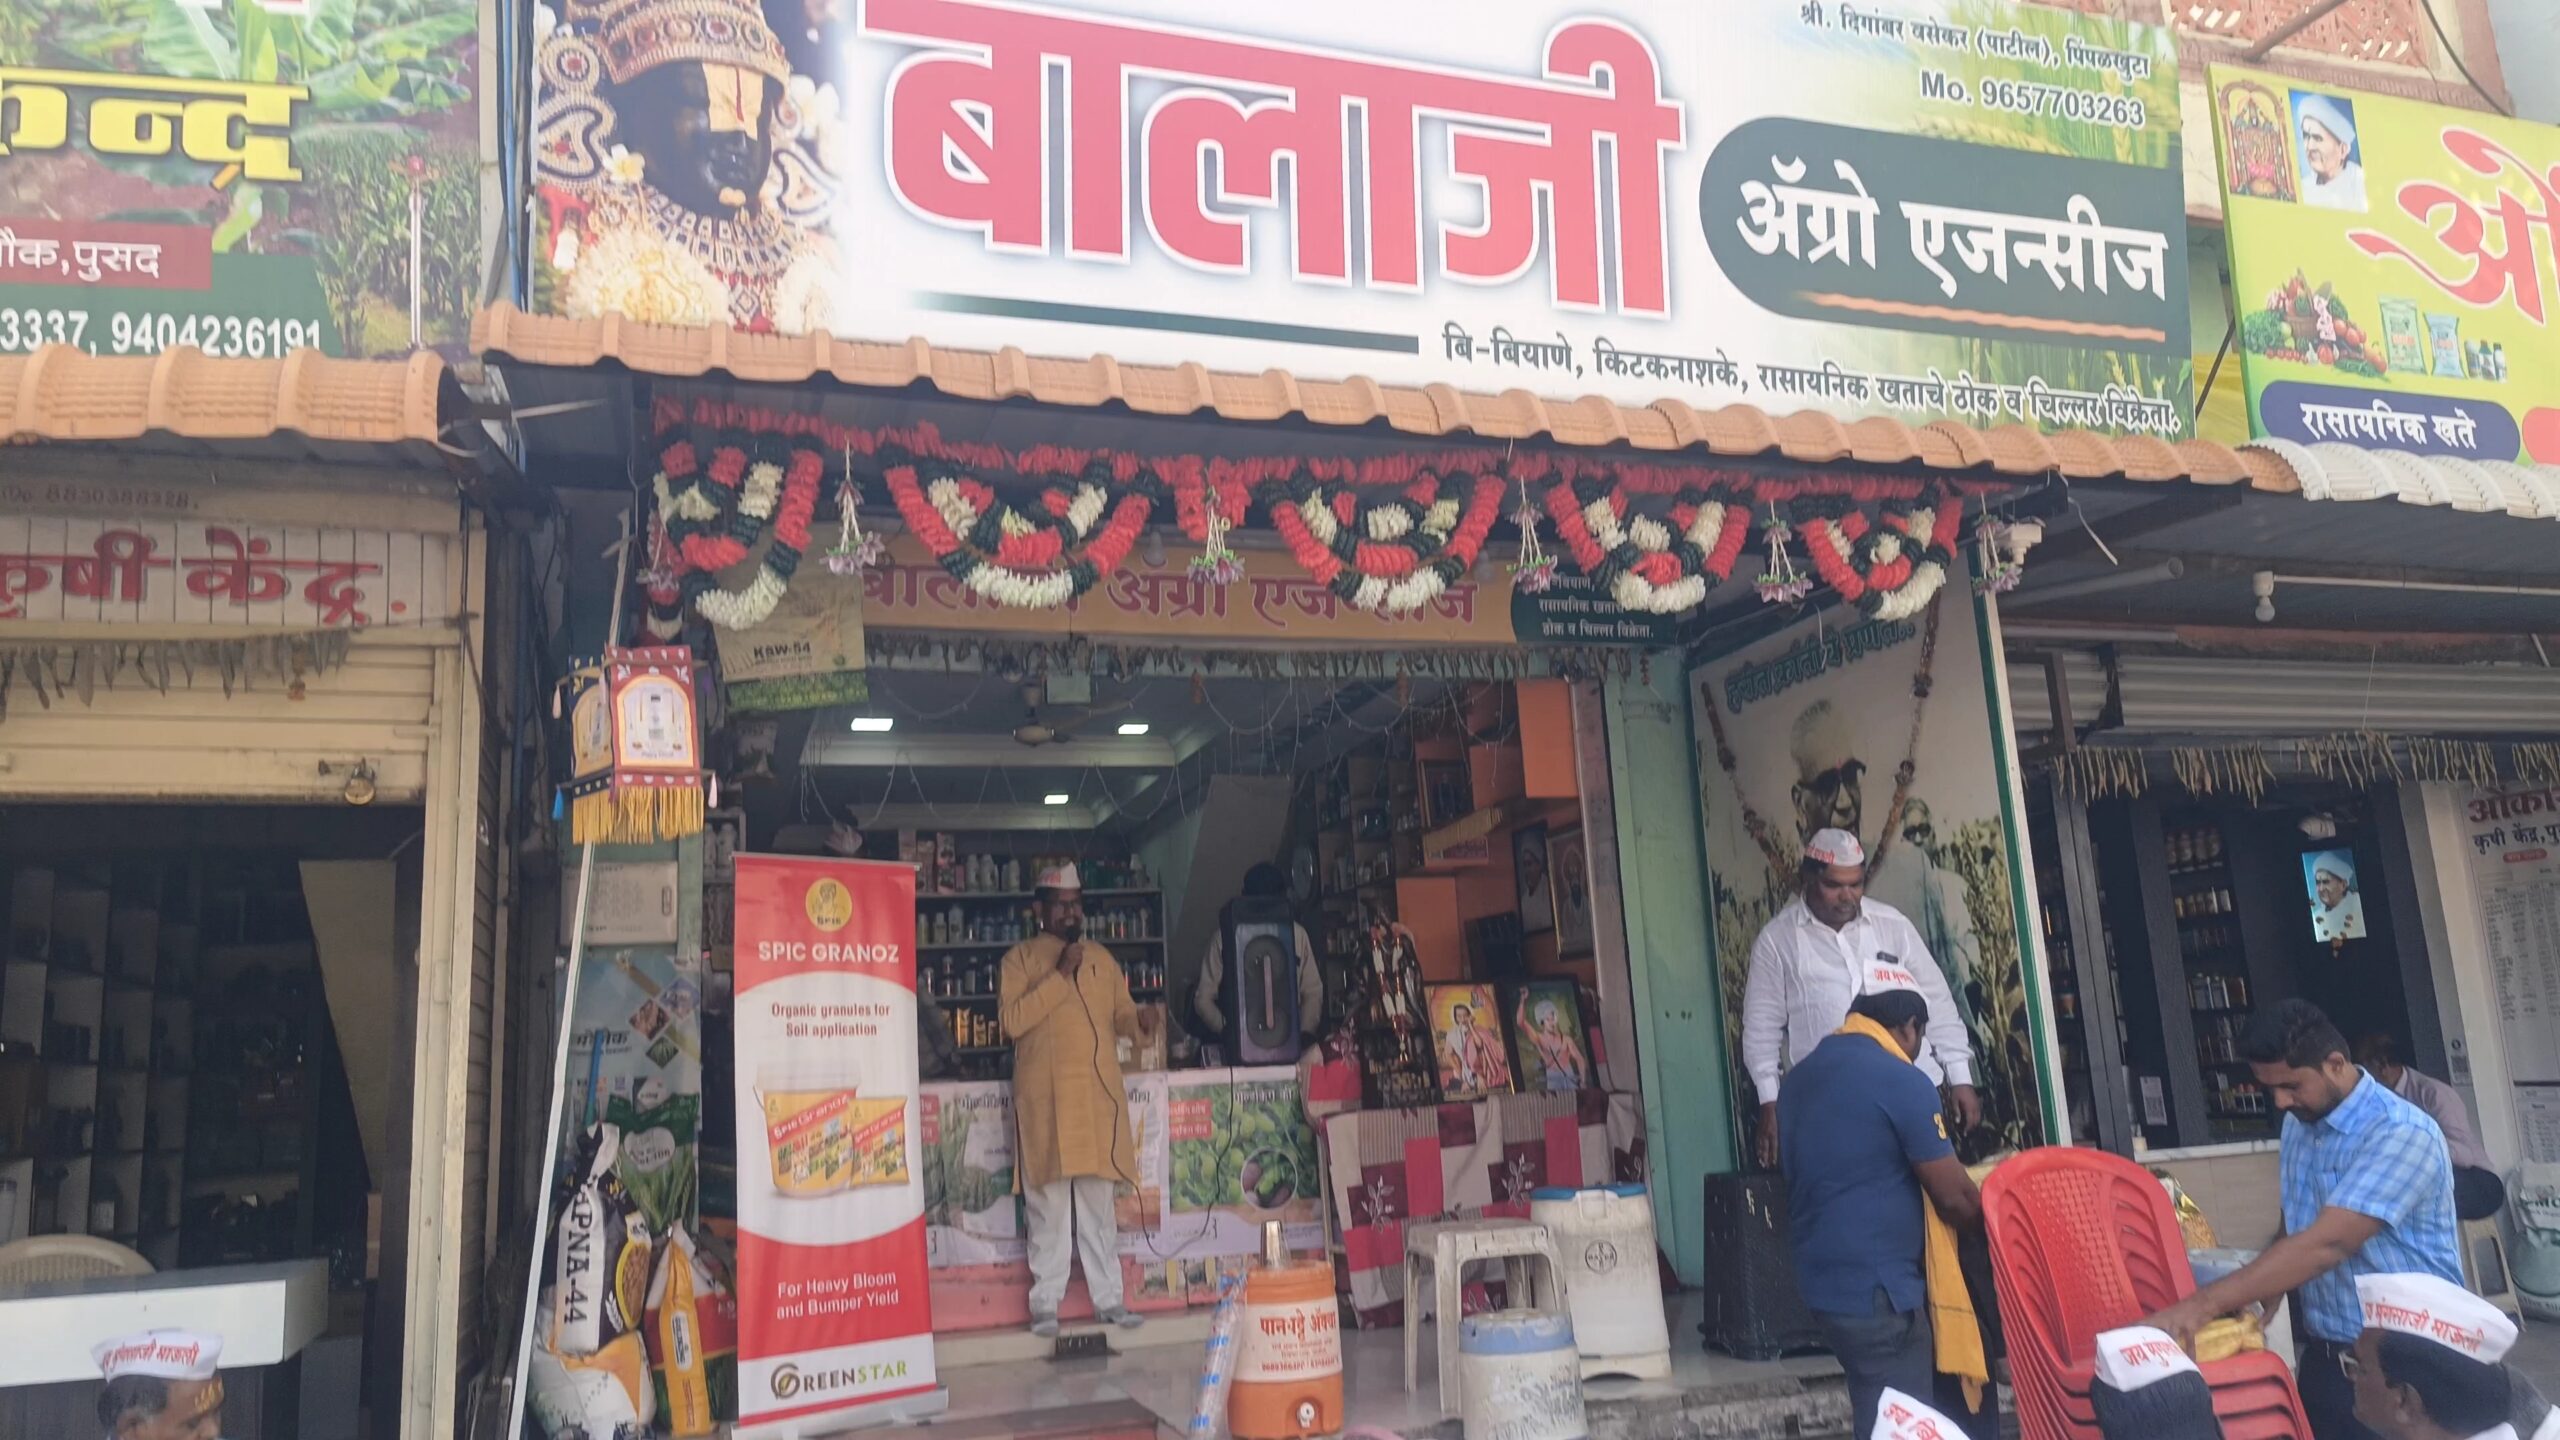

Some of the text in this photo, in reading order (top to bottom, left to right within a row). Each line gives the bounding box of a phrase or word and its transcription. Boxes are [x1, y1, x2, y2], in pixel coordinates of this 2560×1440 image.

[1920, 70, 2145, 126] Mo. 9657703263
[857, 0, 1687, 319] बालाजी
[1899, 194, 2169, 300] एजन्सीज
[111, 310, 321, 359] 9404236191
[1592, 336, 1748, 395] किटकनाशके,
[1757, 360, 1868, 401] रासायनिक
[1875, 368, 1946, 411] खताचे
[1953, 371, 1998, 414] ठोक
[2004, 387, 2021, 418] व
[2028, 377, 2102, 422] चिल्लर
[2300, 398, 2477, 449] रासायनिक खते
[758, 941, 899, 963] SPIC GRANOZ
[771, 1003, 890, 1020] Organic granules for
[786, 1022, 877, 1039] Soil application
[776, 1289, 900, 1320] and Bumper Yield
[777, 1272, 897, 1298] For Heavy Bloom
